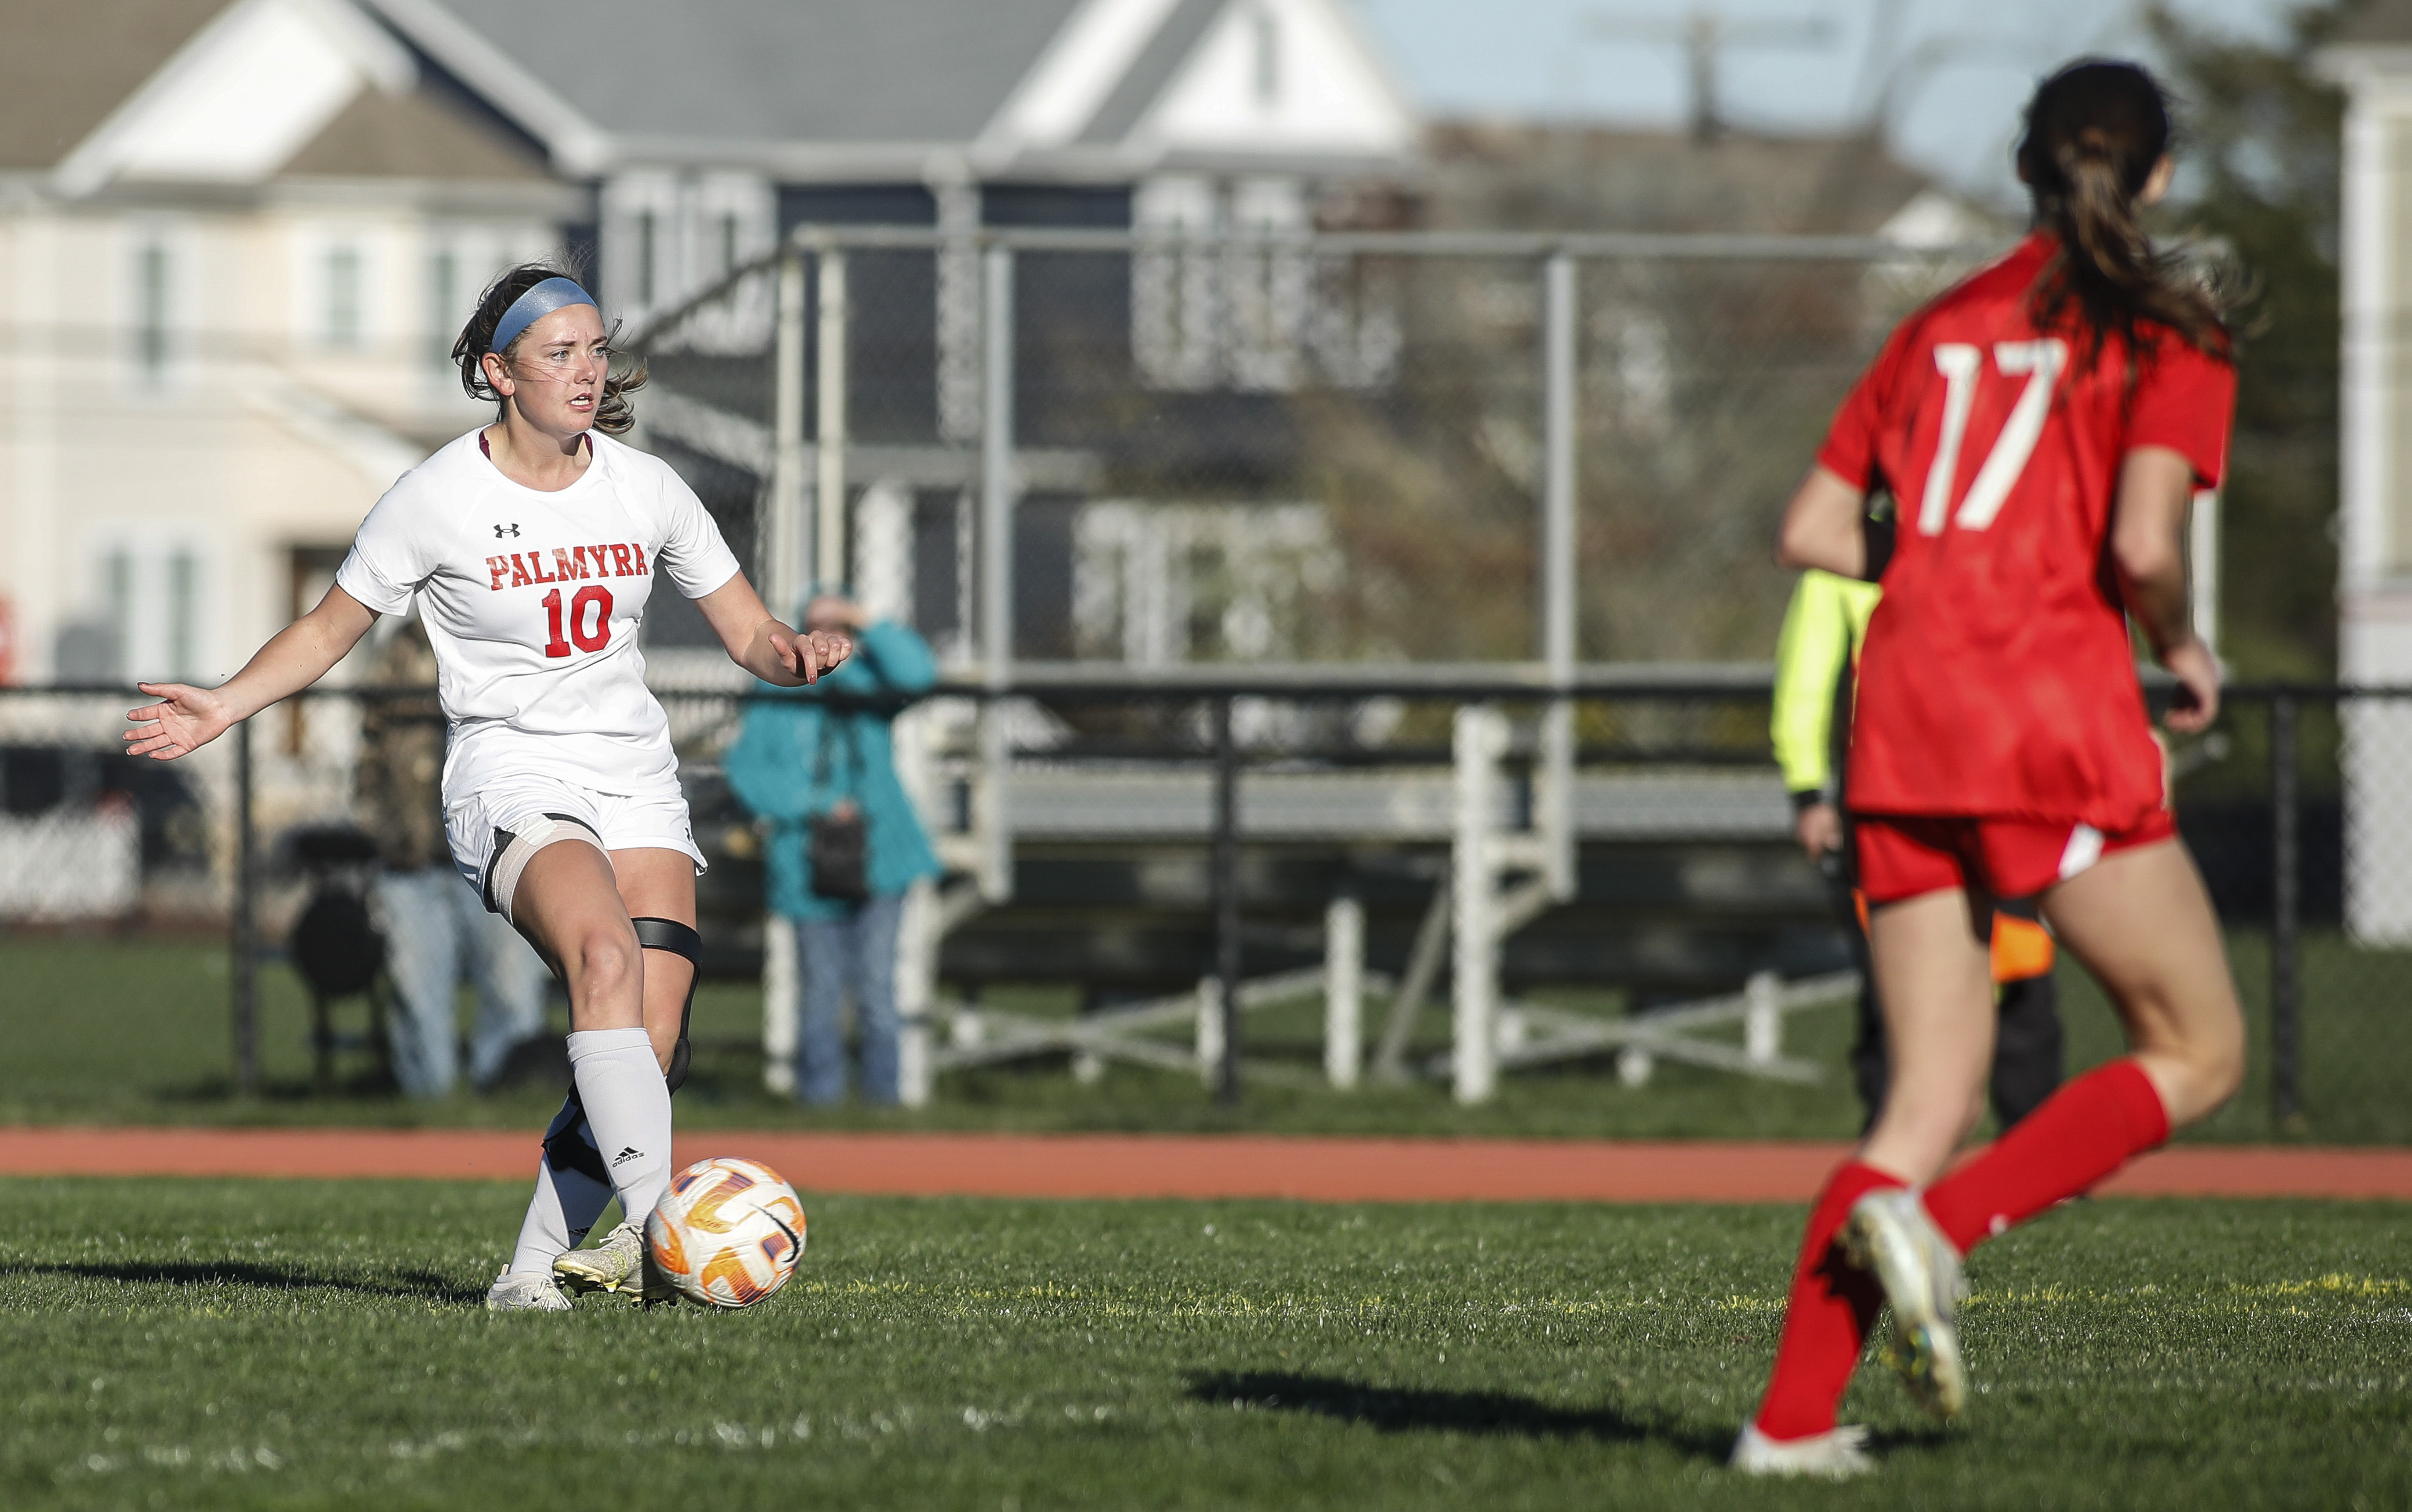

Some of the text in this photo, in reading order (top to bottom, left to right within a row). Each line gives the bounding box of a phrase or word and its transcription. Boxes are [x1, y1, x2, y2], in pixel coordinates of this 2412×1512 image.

[1917, 338, 2069, 536] 17
[485, 543, 648, 591] PALMYRA
[542, 585, 613, 658] 10
[612, 1152, 645, 1168] adidas
